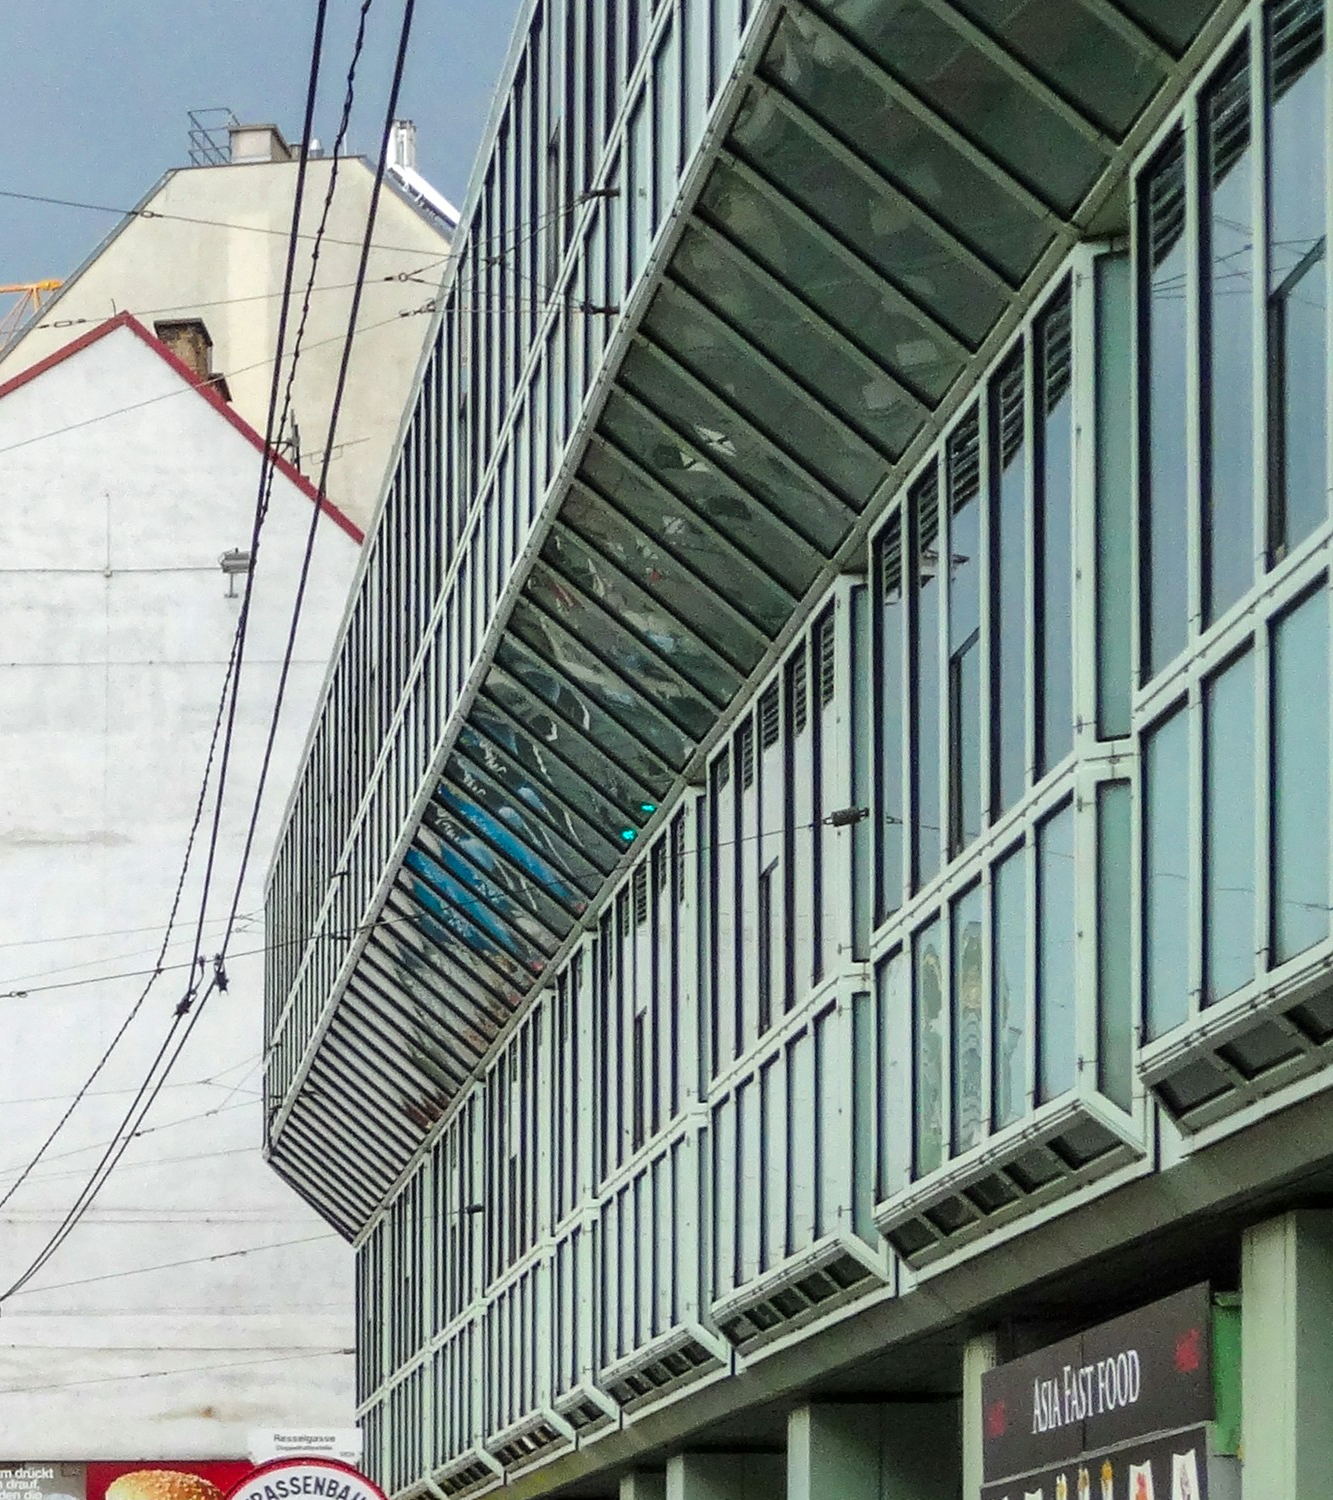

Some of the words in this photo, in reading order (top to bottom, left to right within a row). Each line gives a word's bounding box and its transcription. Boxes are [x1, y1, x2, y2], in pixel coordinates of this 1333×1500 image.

[1097, 1350, 1140, 1413] FOOD
[15, 1467, 54, 1479] drückt
[6, 1479, 40, 1490] drauf,
[24, 1490, 43, 1500] die
